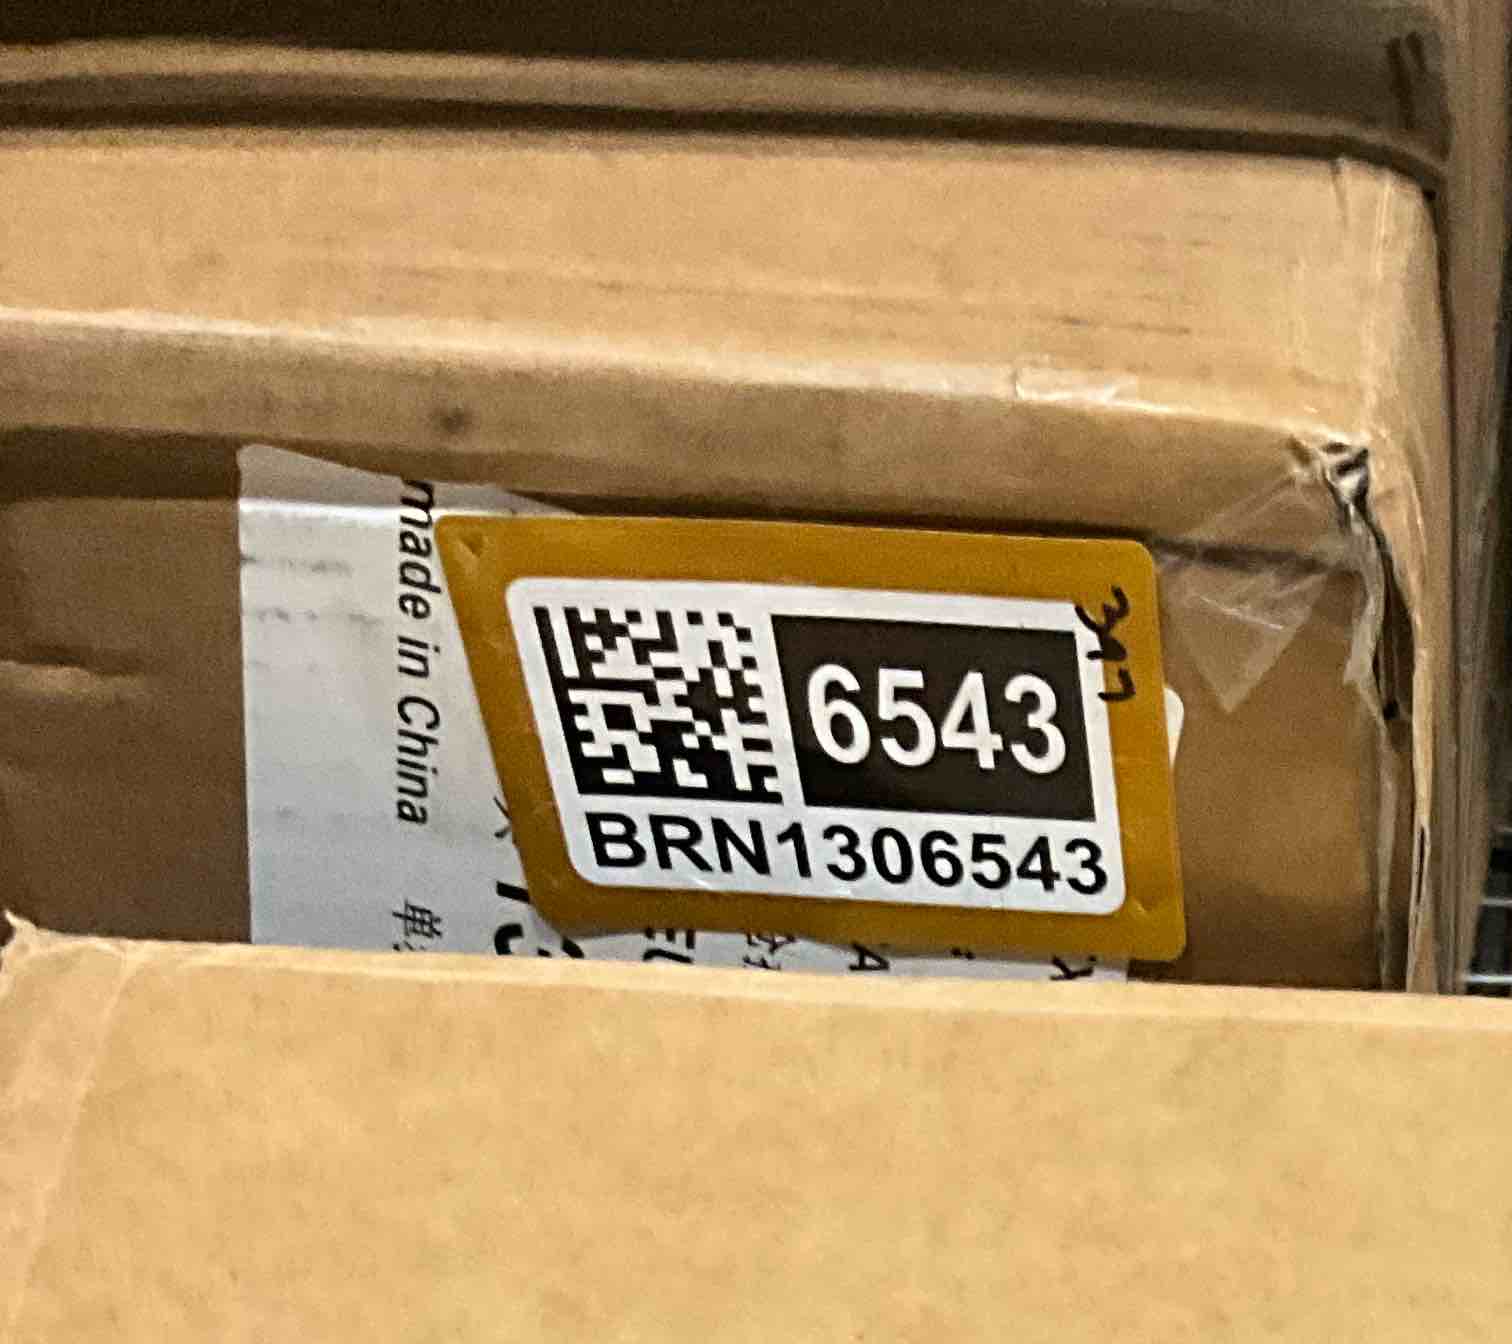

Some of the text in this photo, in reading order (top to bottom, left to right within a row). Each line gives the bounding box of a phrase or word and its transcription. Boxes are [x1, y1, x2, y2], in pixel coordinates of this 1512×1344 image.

[396, 478, 444, 825] made in China
[807, 661, 1069, 776] 6543
[587, 810, 1109, 896] BRN1306543
